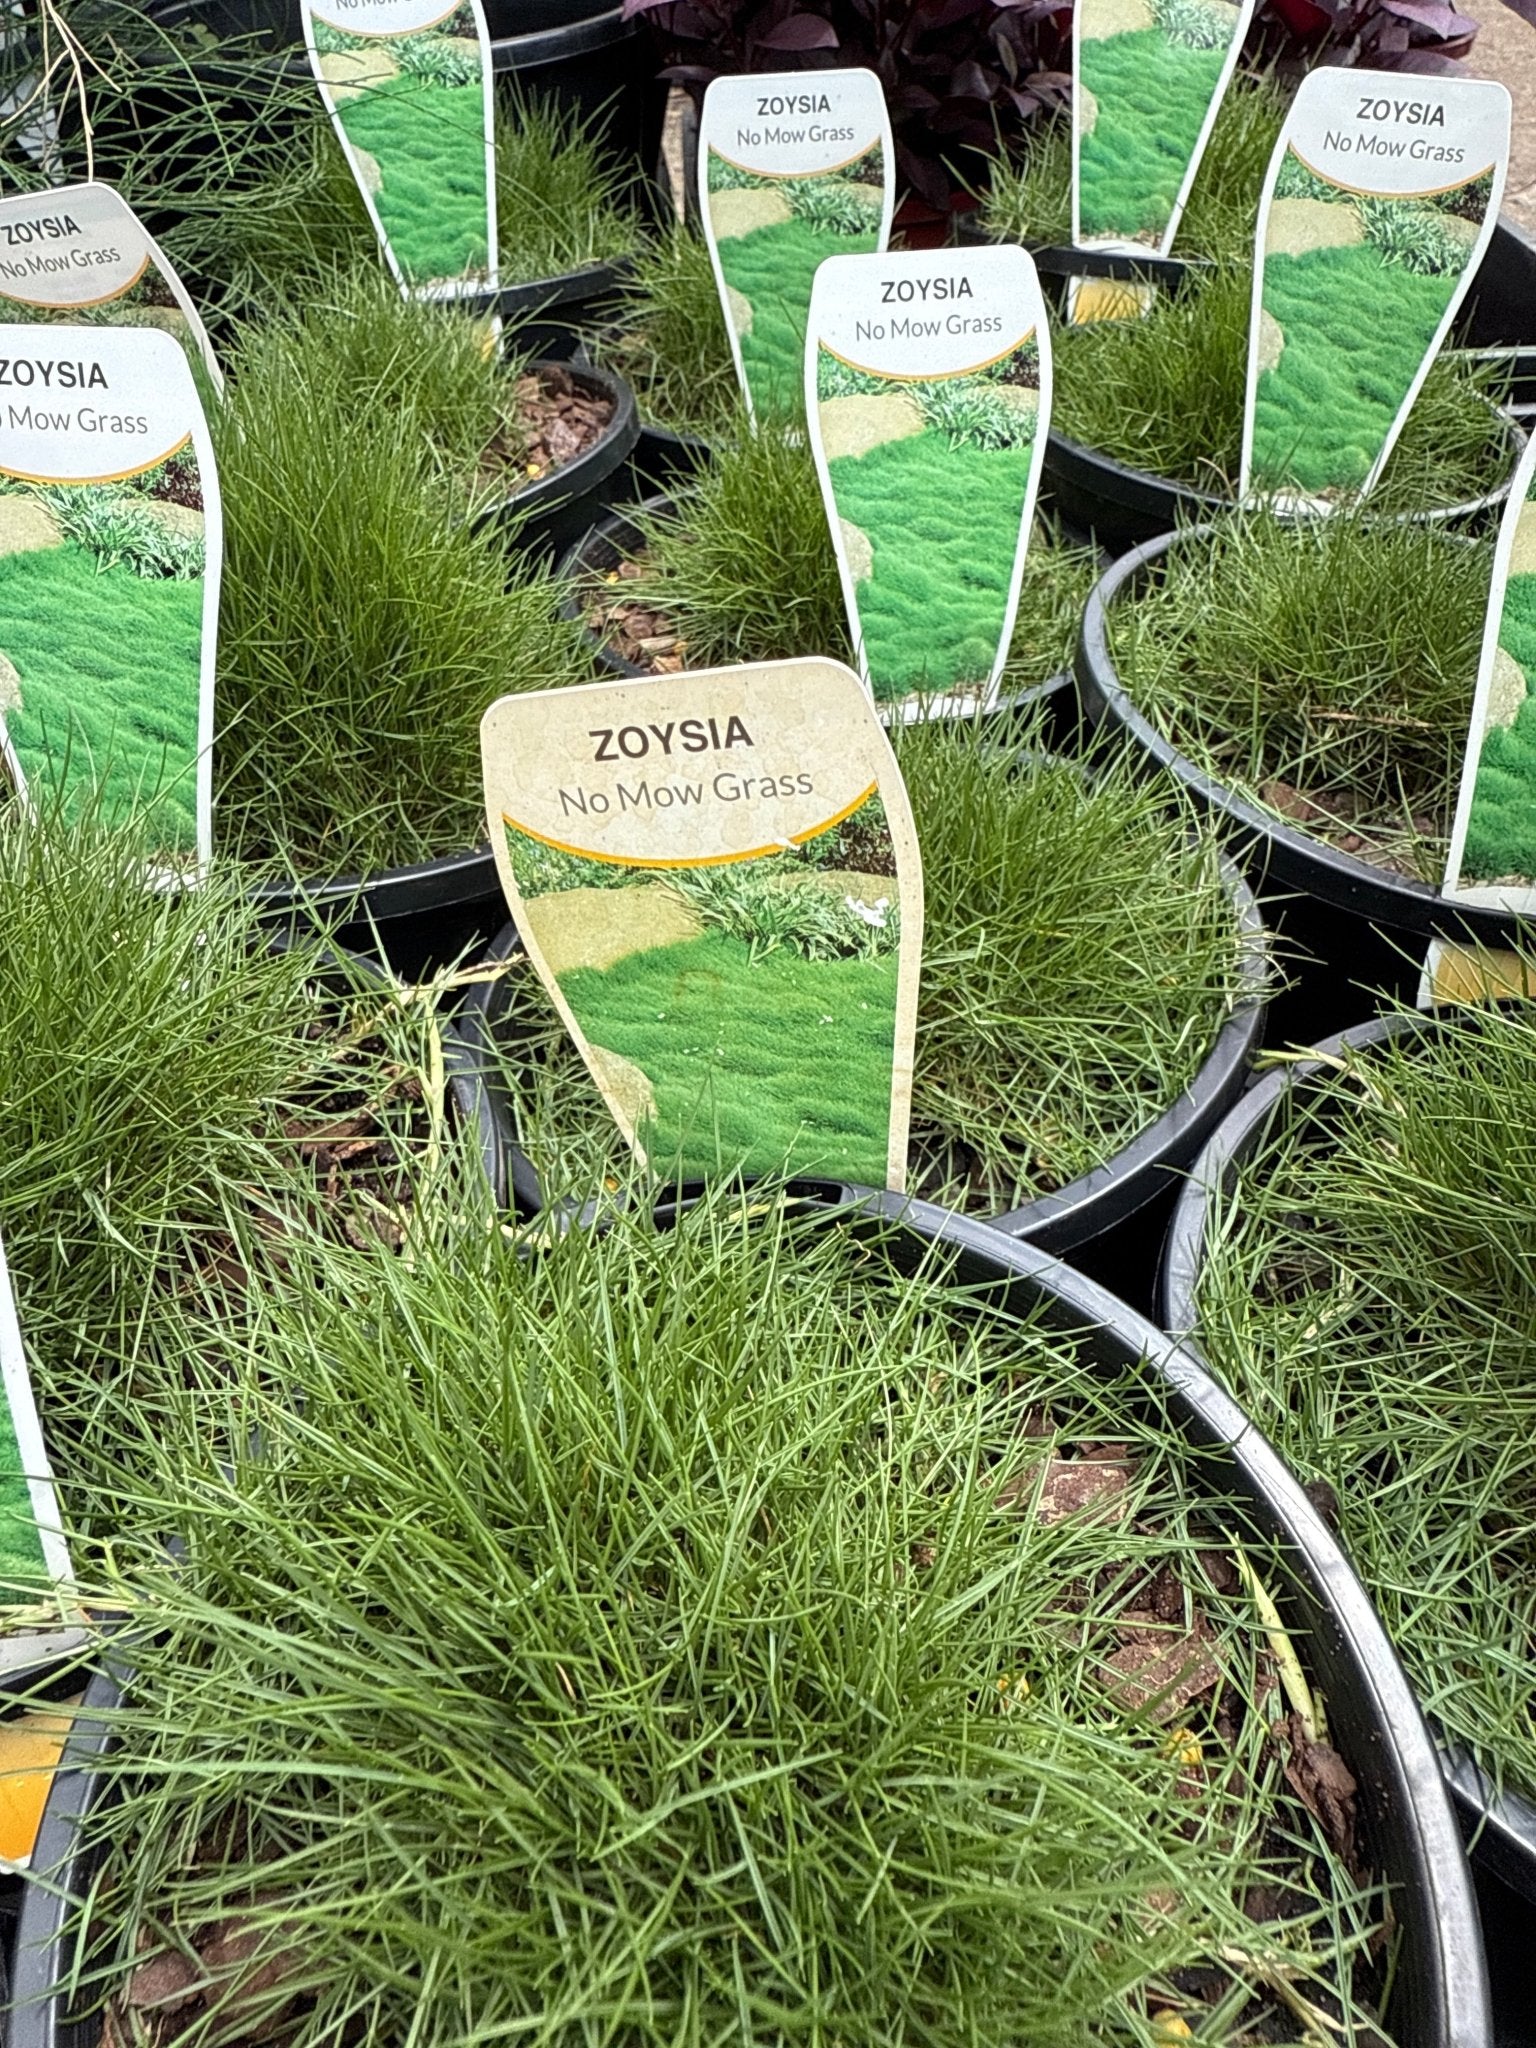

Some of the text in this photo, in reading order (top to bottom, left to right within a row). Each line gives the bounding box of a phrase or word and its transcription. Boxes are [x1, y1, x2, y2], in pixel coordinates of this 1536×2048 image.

[756, 94, 832, 117] ZOYSIA
[1356, 97, 1445, 127] ZOYSIA
[736, 124, 855, 147] No Mow Grass
[1323, 130, 1466, 164] No Mow Grass
[0, 214, 83, 246] ZOYSIA
[0, 247, 122, 280] No Mow Grass
[880, 276, 974, 304] ZOYSIA
[855, 314, 1003, 342] No Mow Grass
[7, 404, 71, 431] Mow
[77, 407, 148, 435] Grass
[588, 715, 755, 762] ZOYSIA
[558, 772, 814, 817] No Mow Grass
